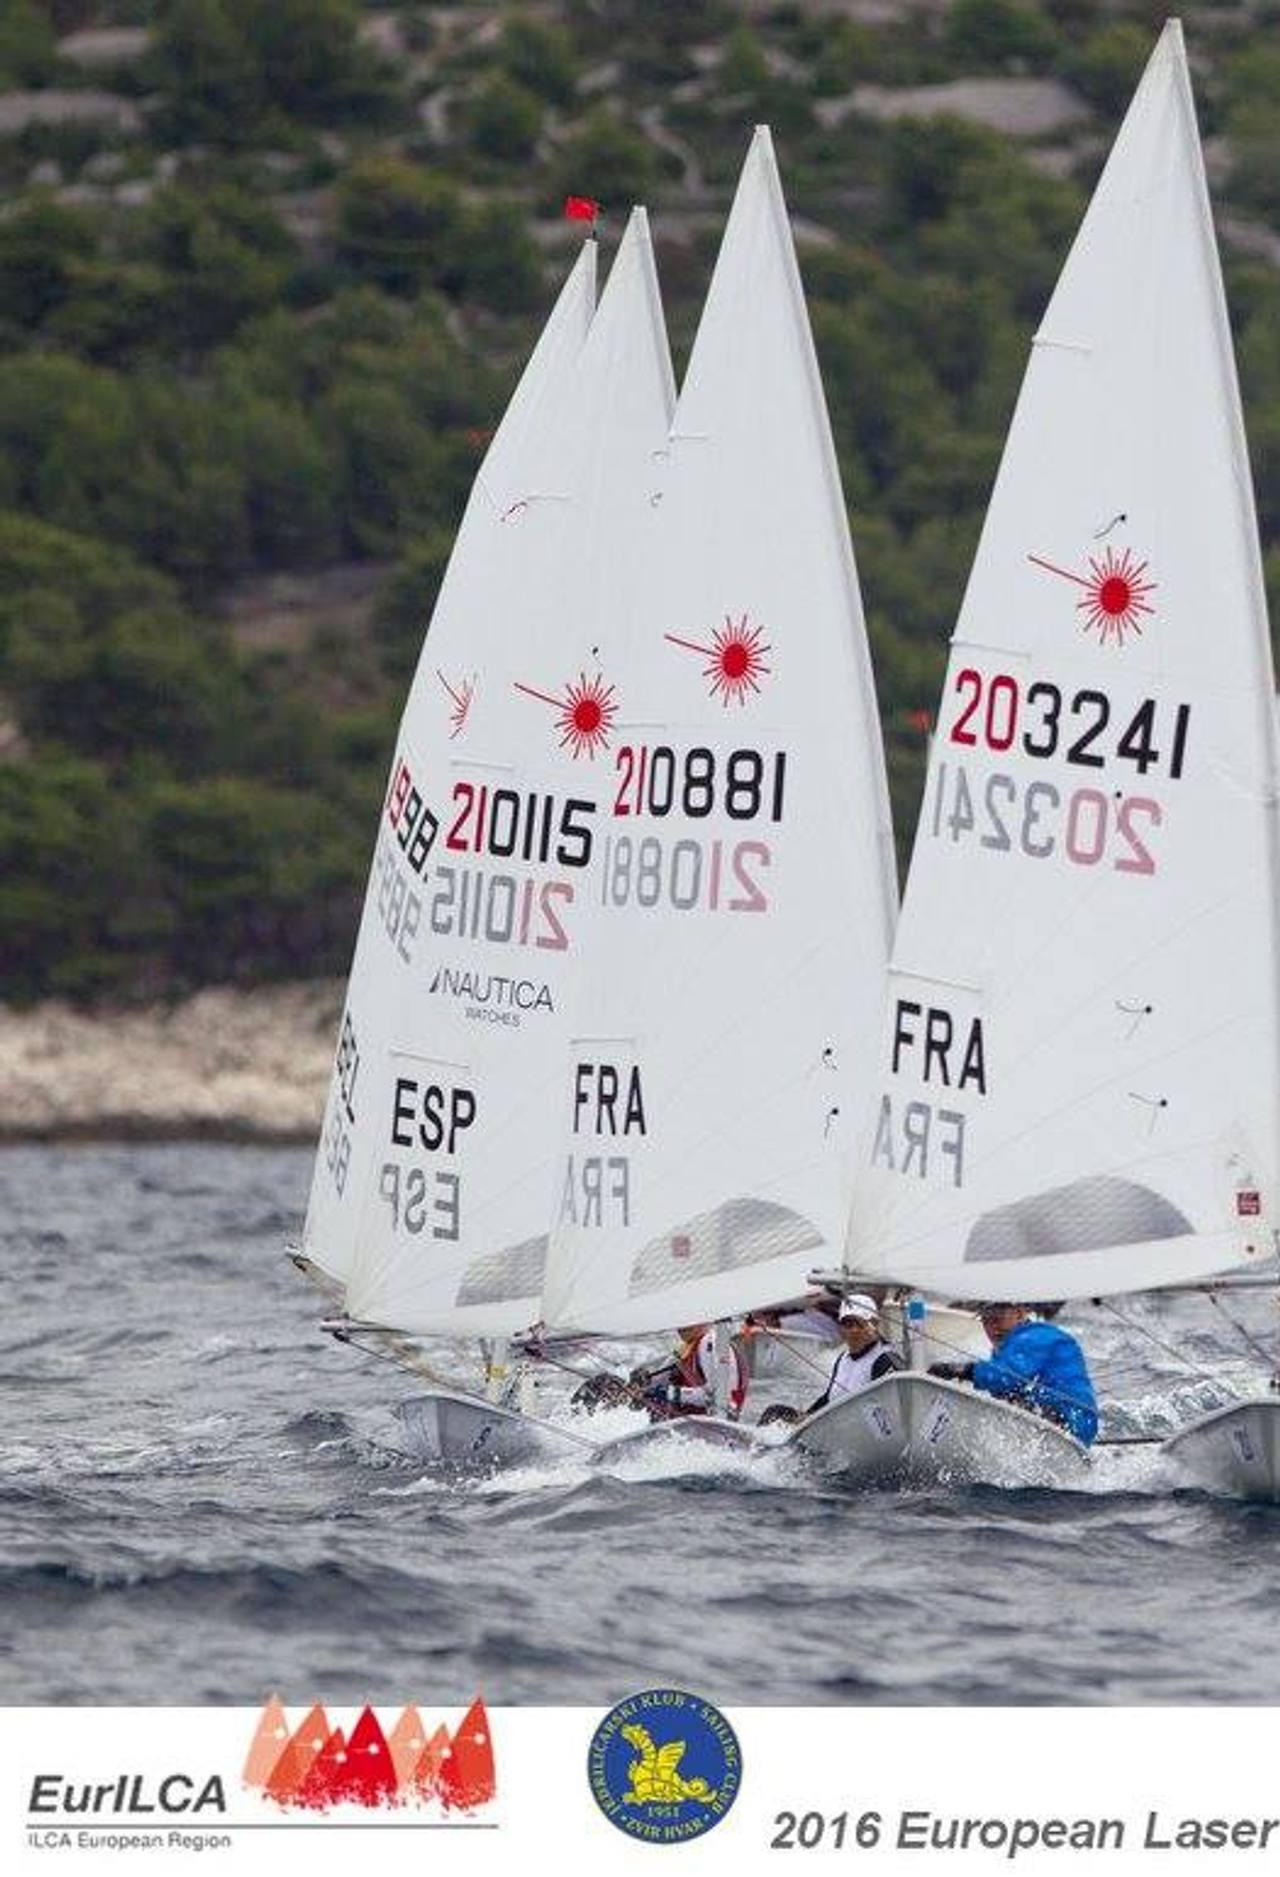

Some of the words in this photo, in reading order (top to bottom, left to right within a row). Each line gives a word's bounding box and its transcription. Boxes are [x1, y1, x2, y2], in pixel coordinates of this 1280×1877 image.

[949, 668, 1191, 780] 203241
[612, 746, 787, 822] 210881
[446, 782, 597, 867] 210115
[430, 968, 554, 1012] NAUTICA
[891, 1000, 987, 1096] FRA
[391, 1077, 476, 1154] ESP
[572, 1064, 647, 1136] FRA
